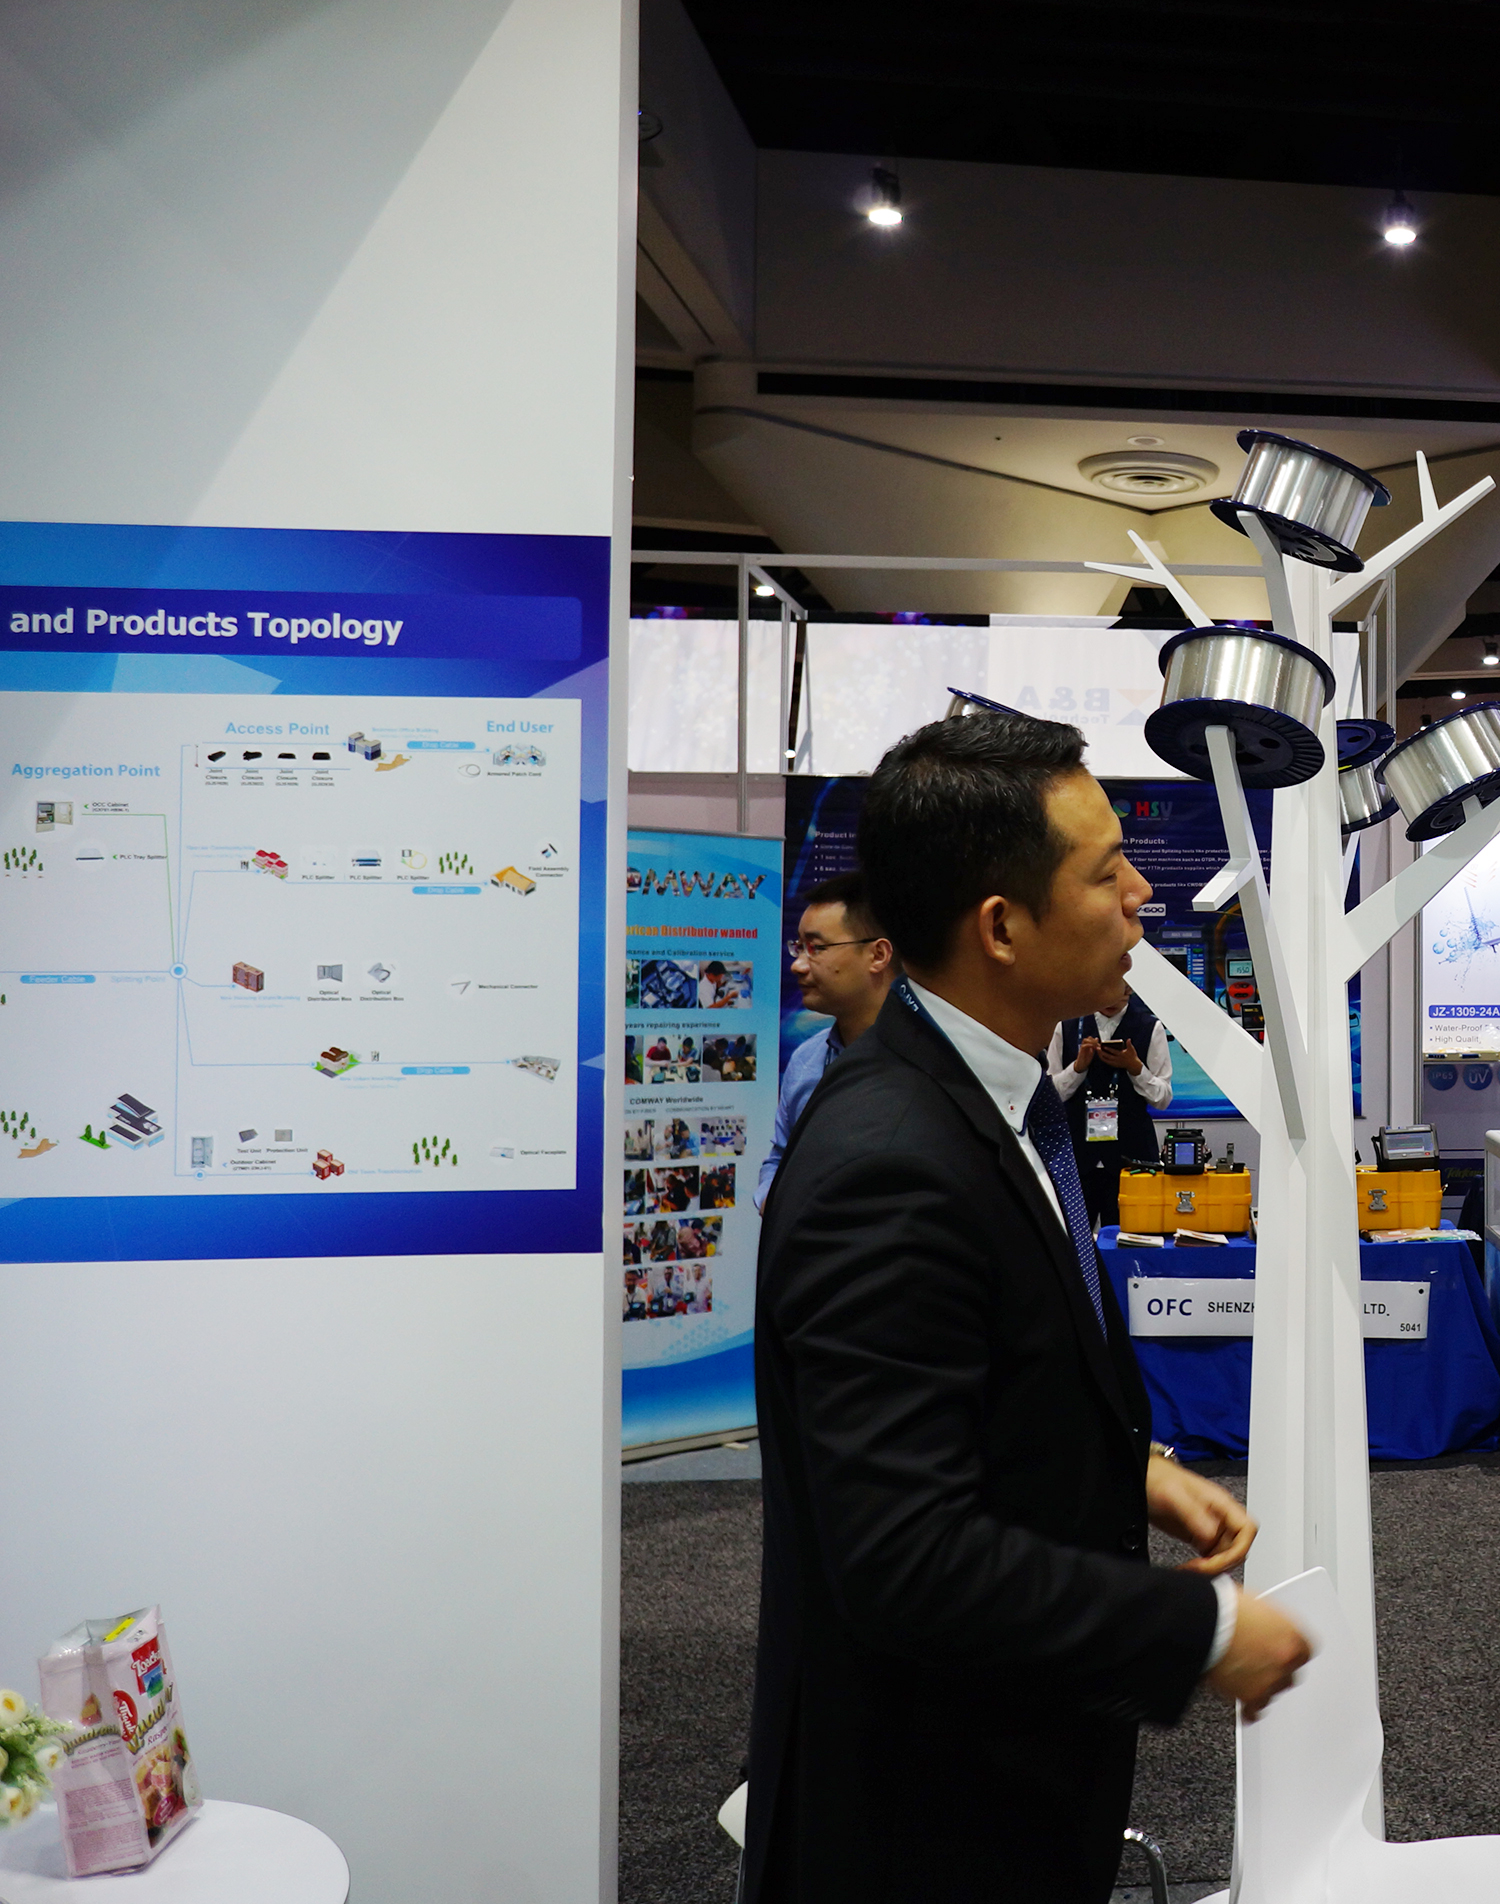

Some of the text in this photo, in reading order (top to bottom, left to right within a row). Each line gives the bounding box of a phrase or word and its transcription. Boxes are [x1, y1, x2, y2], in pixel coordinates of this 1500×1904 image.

[10, 608, 403, 645] and Products Topology
[225, 722, 330, 735] Access Point
[487, 721, 554, 733] End User
[12, 763, 161, 779] Aggregation Point
[627, 867, 767, 899] OMWAY
[661, 925, 718, 938] Distributor
[720, 928, 758, 939] wanted
[1433, 1007, 1500, 1017] JZ-1309-24A
[1435, 1036, 1453, 1044] High
[1147, 1299, 1193, 1316] OFC
[1364, 1304, 1390, 1316] LTD.
[1400, 1323, 1421, 1332] 5041
